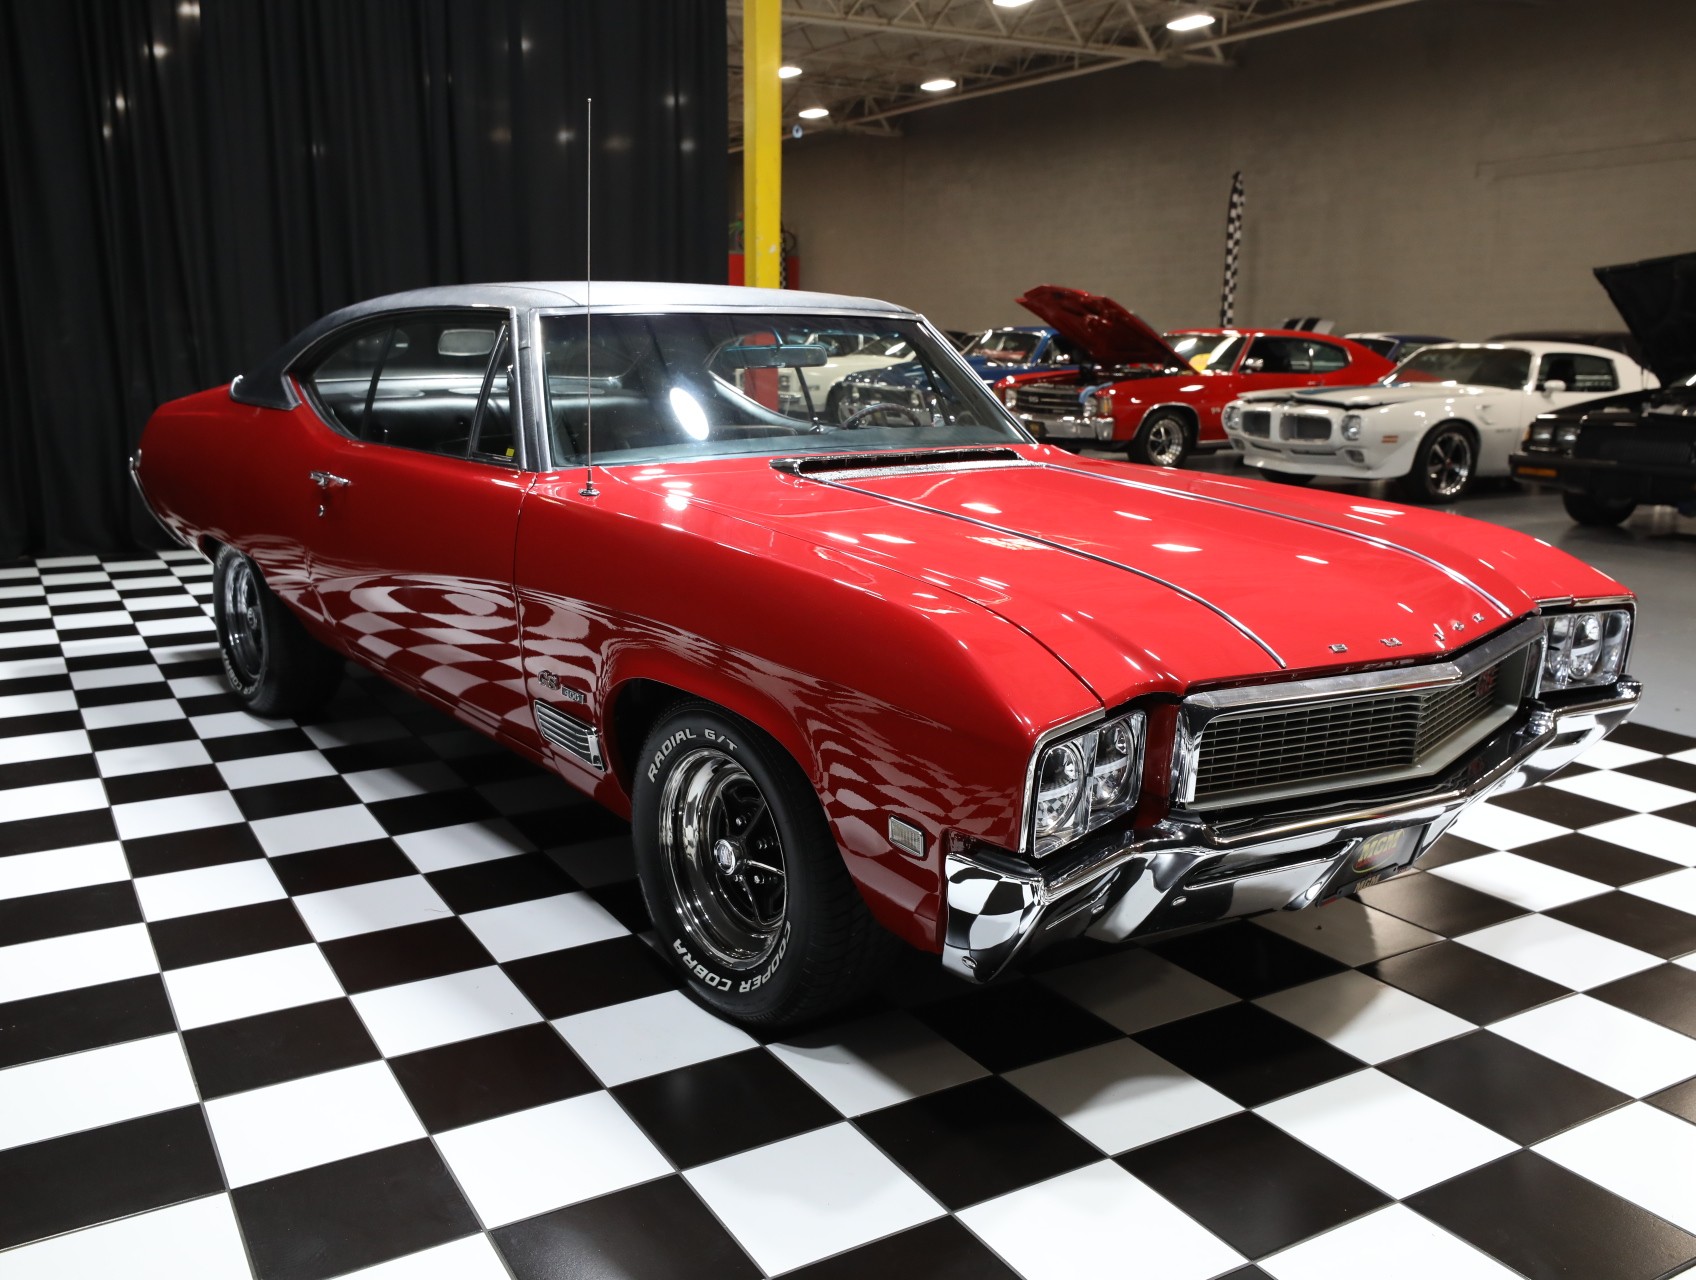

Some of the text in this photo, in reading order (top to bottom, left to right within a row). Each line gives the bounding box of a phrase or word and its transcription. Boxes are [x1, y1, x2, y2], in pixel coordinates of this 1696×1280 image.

[647, 728, 738, 783] RADIAL G/T
[672, 920, 791, 993] COOPER COBRA
